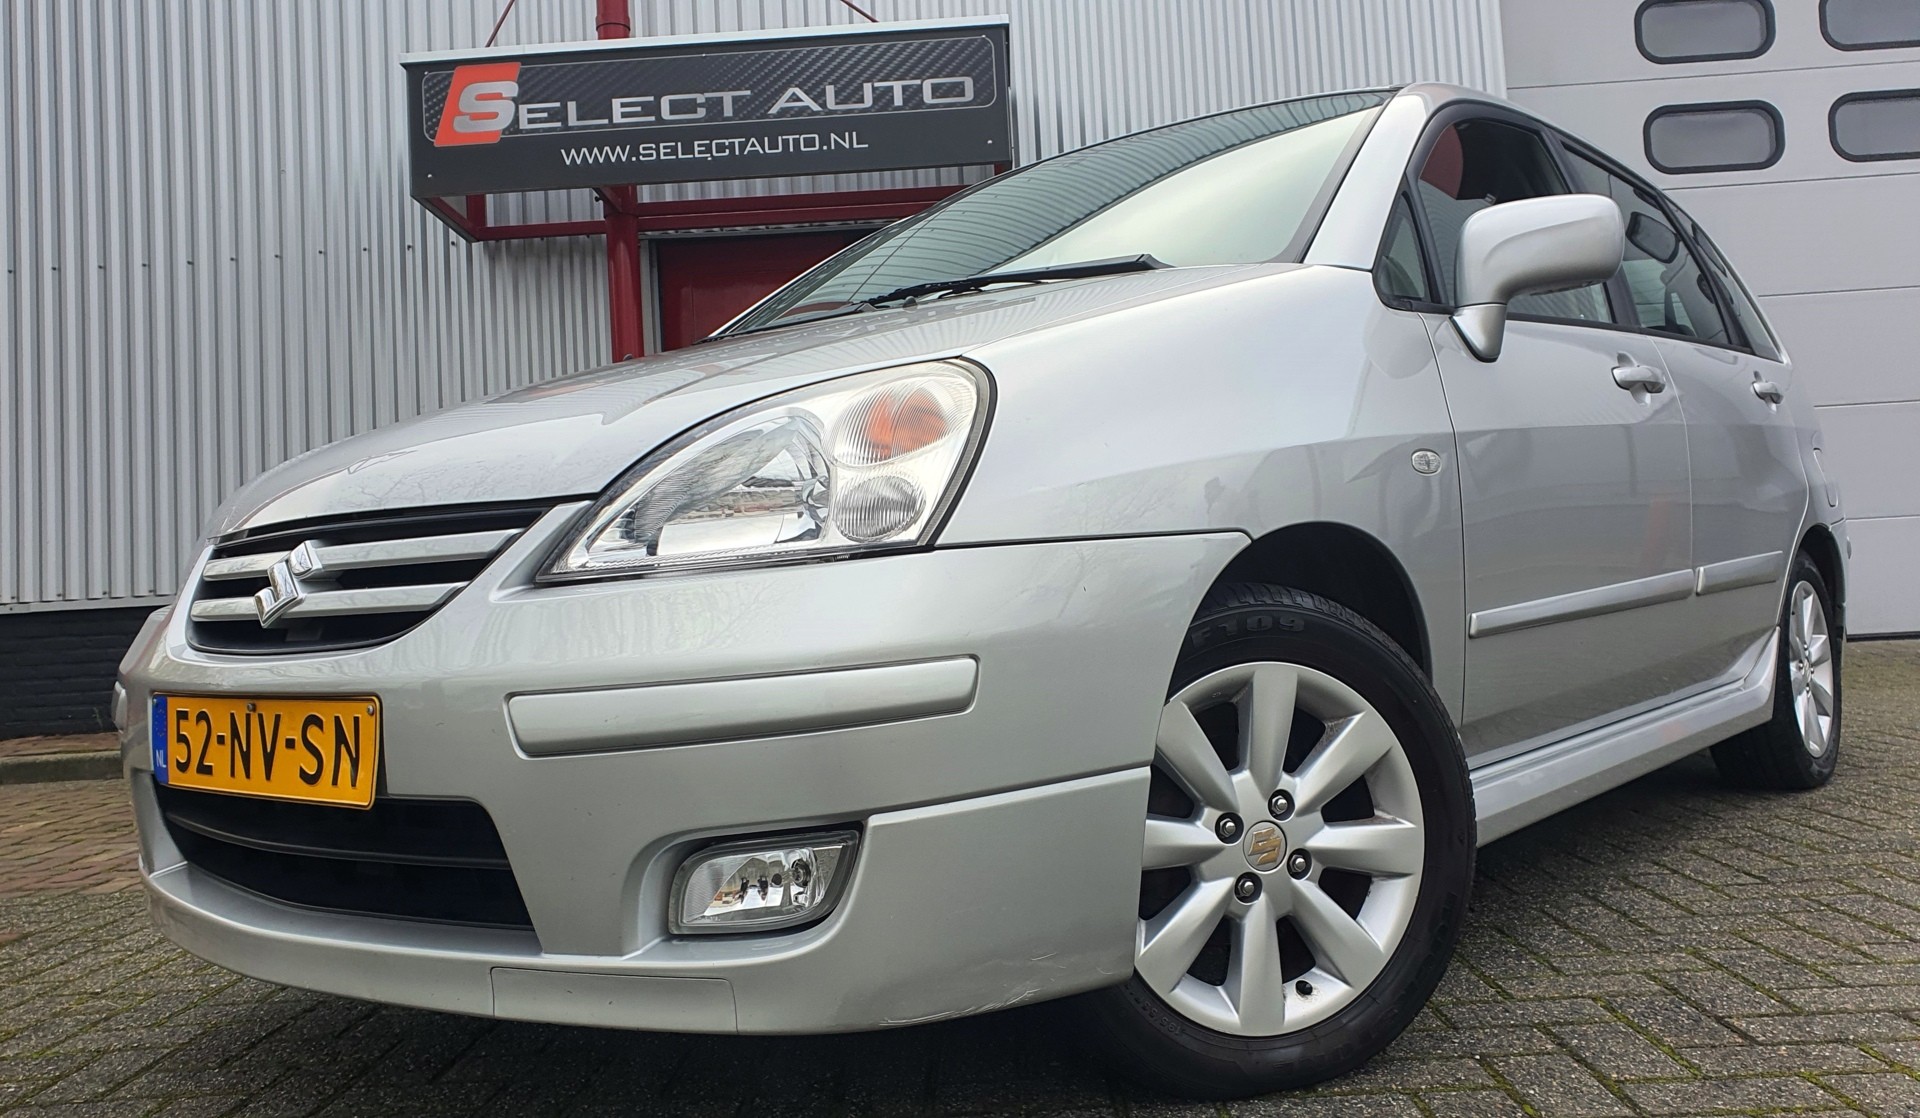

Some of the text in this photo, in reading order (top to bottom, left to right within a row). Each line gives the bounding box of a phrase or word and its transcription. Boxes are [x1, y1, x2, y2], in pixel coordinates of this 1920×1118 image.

[453, 76, 975, 133] SELECT AUTO
[560, 131, 869, 165] WWW.SELECTAUTO.NL
[1190, 614, 1305, 649] F109
[155, 749, 167, 768] NL
[175, 708, 361, 788] 52-NV-SN
